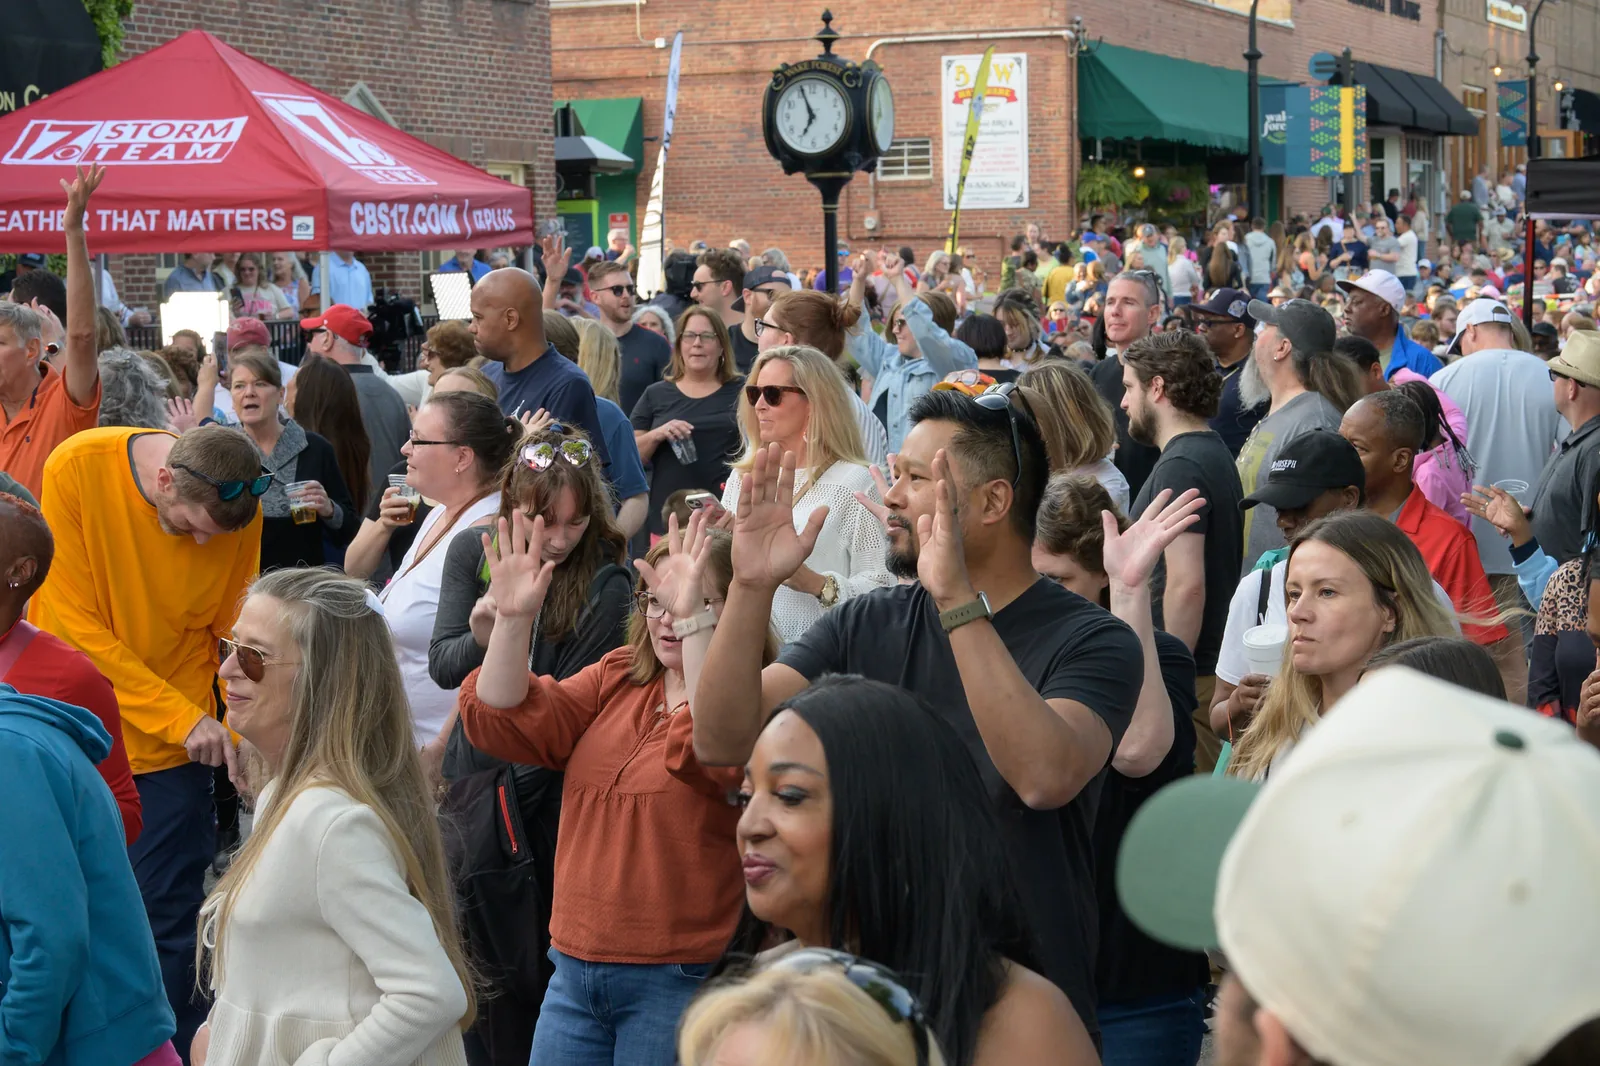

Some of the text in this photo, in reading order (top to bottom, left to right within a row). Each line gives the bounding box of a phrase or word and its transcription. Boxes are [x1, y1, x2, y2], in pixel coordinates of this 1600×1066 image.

[784, 60, 843, 77] WAKE FOREST
[24, 84, 49, 107] C
[104, 122, 235, 141] STORM
[97, 143, 222, 161] TEAM
[96, 209, 160, 231] THAT
[167, 208, 287, 231] MATTERS
[350, 201, 460, 235] CBS17.COM
